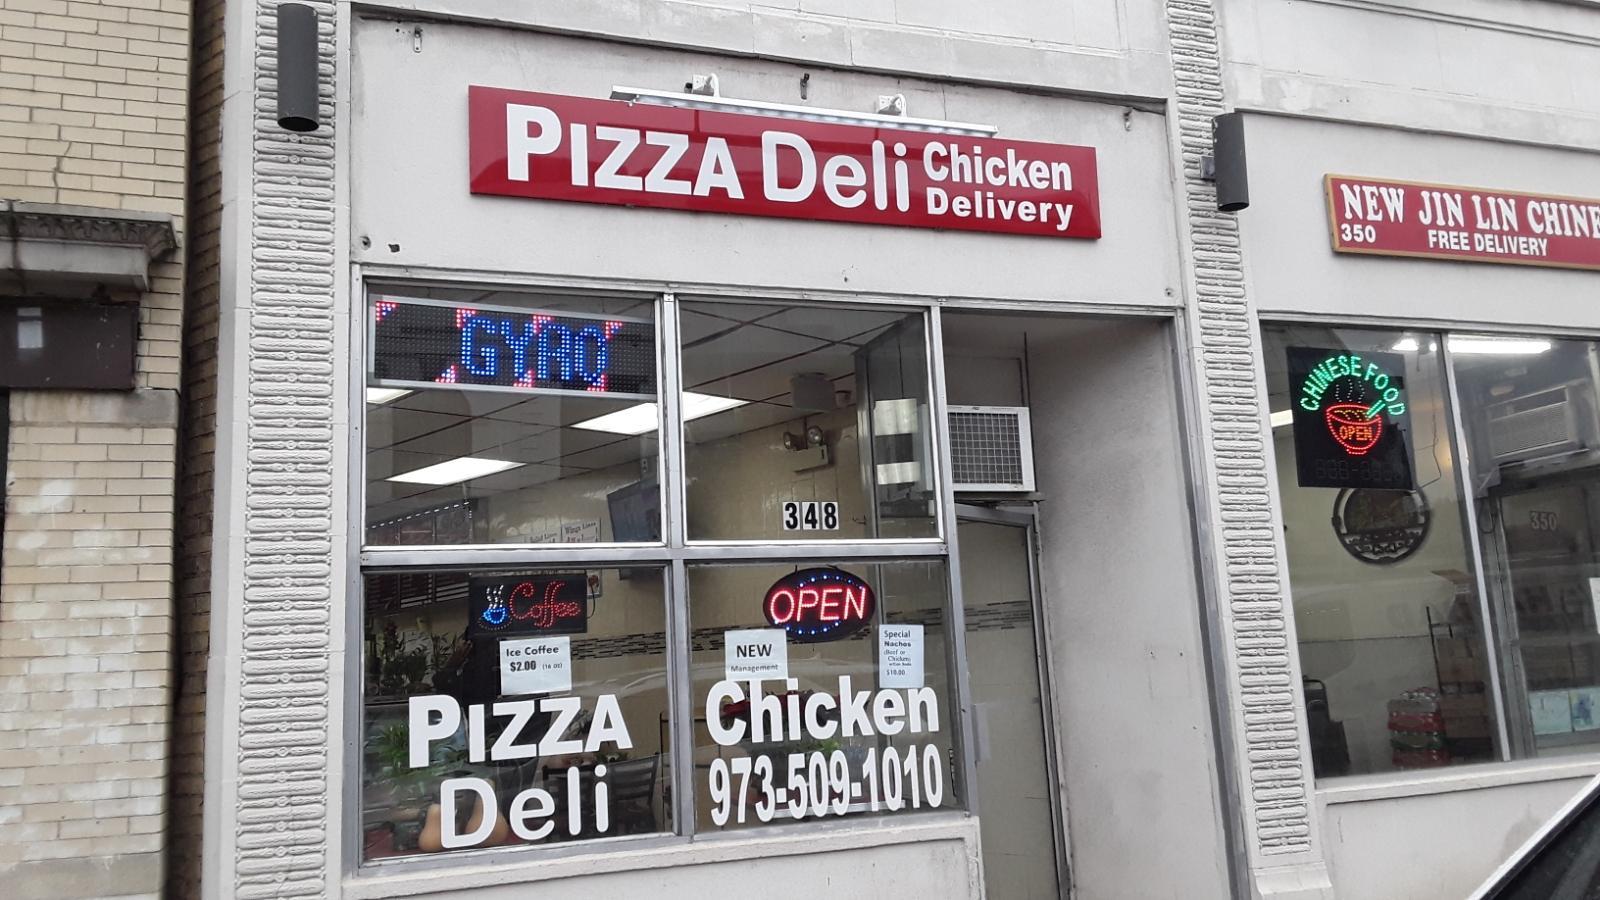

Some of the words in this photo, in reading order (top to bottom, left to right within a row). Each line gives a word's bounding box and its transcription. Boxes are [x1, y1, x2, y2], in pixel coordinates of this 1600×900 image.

[506, 103, 745, 200] PIZZA
[762, 130, 911, 213] Deli
[924, 140, 1074, 191] Chicken
[926, 188, 1074, 232] Delivery
[1340, 183, 1405, 223] NEW
[1418, 189, 1465, 228] JIN
[1471, 194, 1519, 232] LIN
[1527, 200, 1600, 239] CHINE
[1341, 223, 1376, 244] 350
[1428, 229, 1471, 252] FREE
[1474, 233, 1548, 257] DELIVERY
[1300, 355, 1362, 411] CHINESE
[1363, 362, 1406, 416] FOOD
[1339, 425, 1374, 442] OPEN
[784, 502, 837, 530] 348
[1531, 511, 1557, 531] 350
[509, 581, 581, 628] Coffee
[770, 587, 866, 623] OPEN
[506, 648, 521, 657] Ice
[524, 644, 560, 656] Coffee
[736, 643, 773, 658] NEW
[883, 630, 911, 640] Special
[510, 660, 537, 672] $2.00
[730, 663, 779, 673] Management
[705, 675, 940, 747] Chicken
[409, 694, 633, 769] PIZZA
[708, 743, 943, 827] 973-509-1010
[440, 764, 610, 850] Deli
